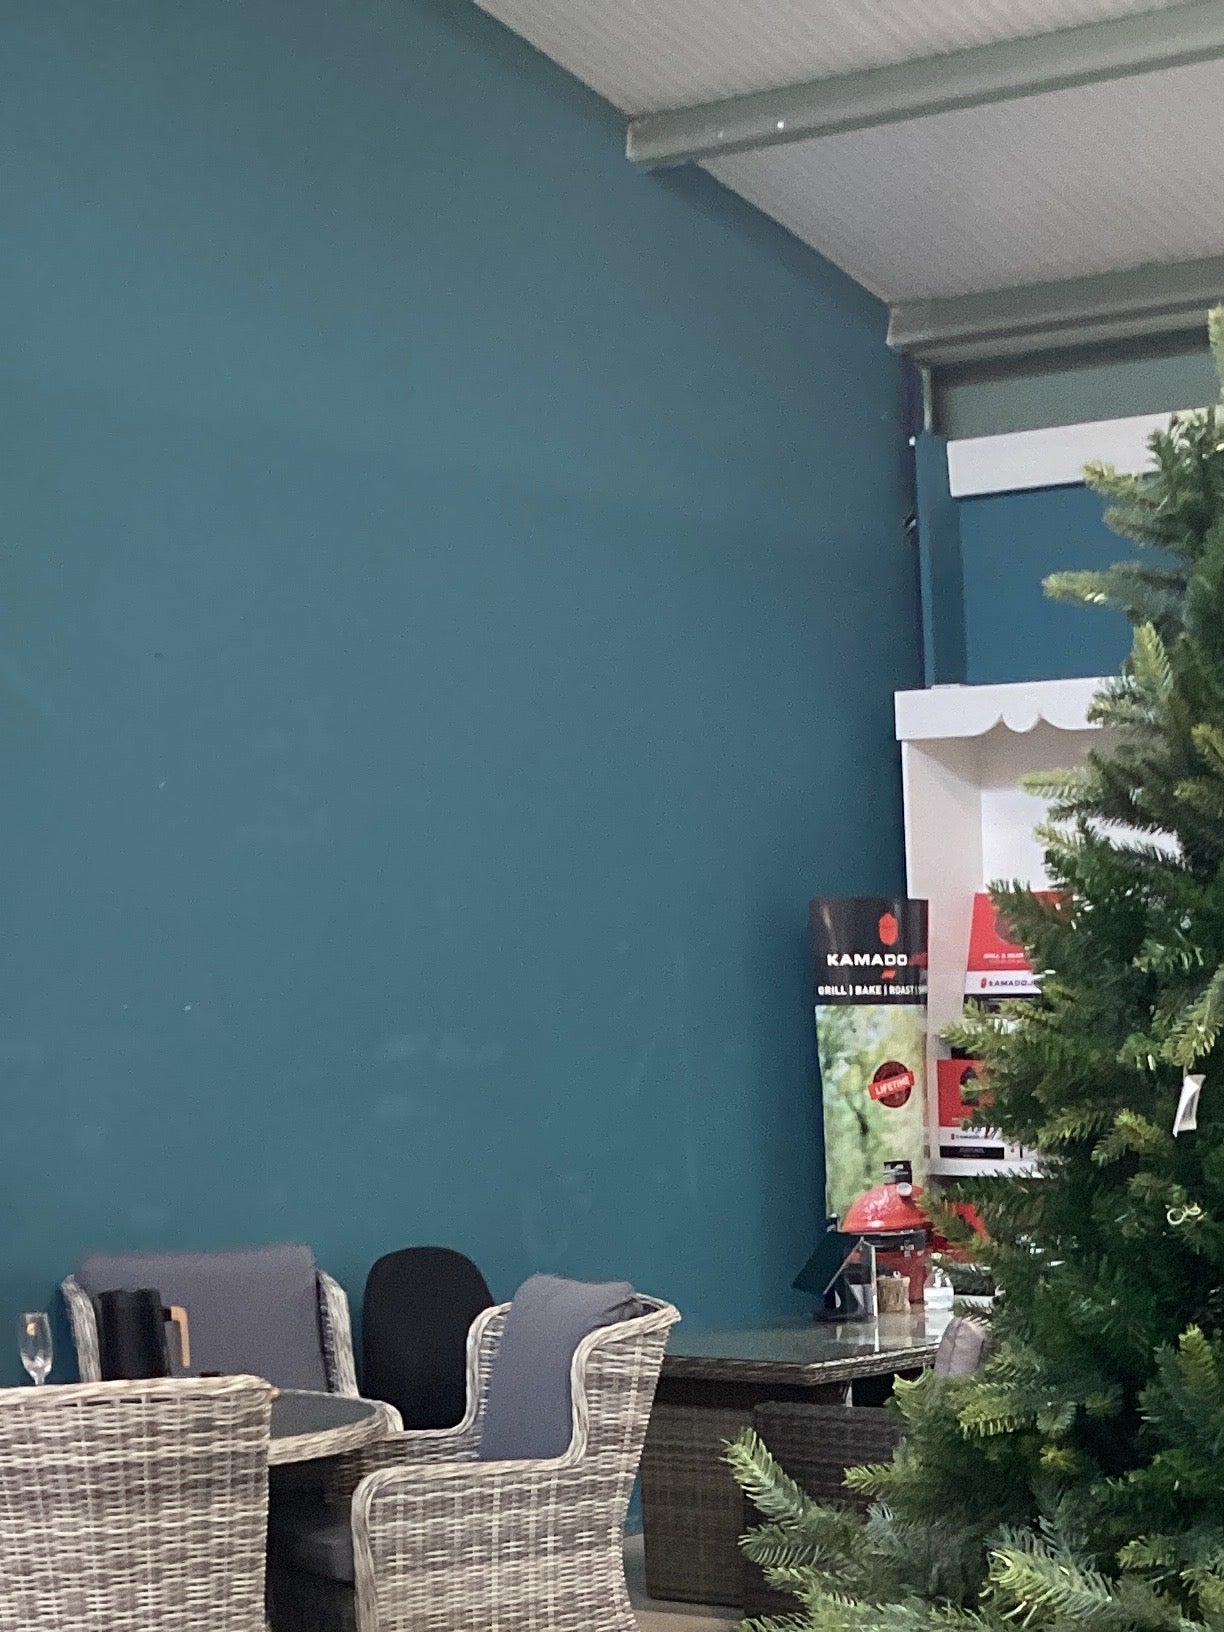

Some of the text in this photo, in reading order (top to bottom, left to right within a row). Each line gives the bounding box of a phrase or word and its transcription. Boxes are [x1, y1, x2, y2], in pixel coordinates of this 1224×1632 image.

[826, 953, 908, 967] KAMADO
[818, 985, 847, 996] GRILL
[855, 984, 882, 996] BAKE
[889, 985, 915, 996] ROAST
